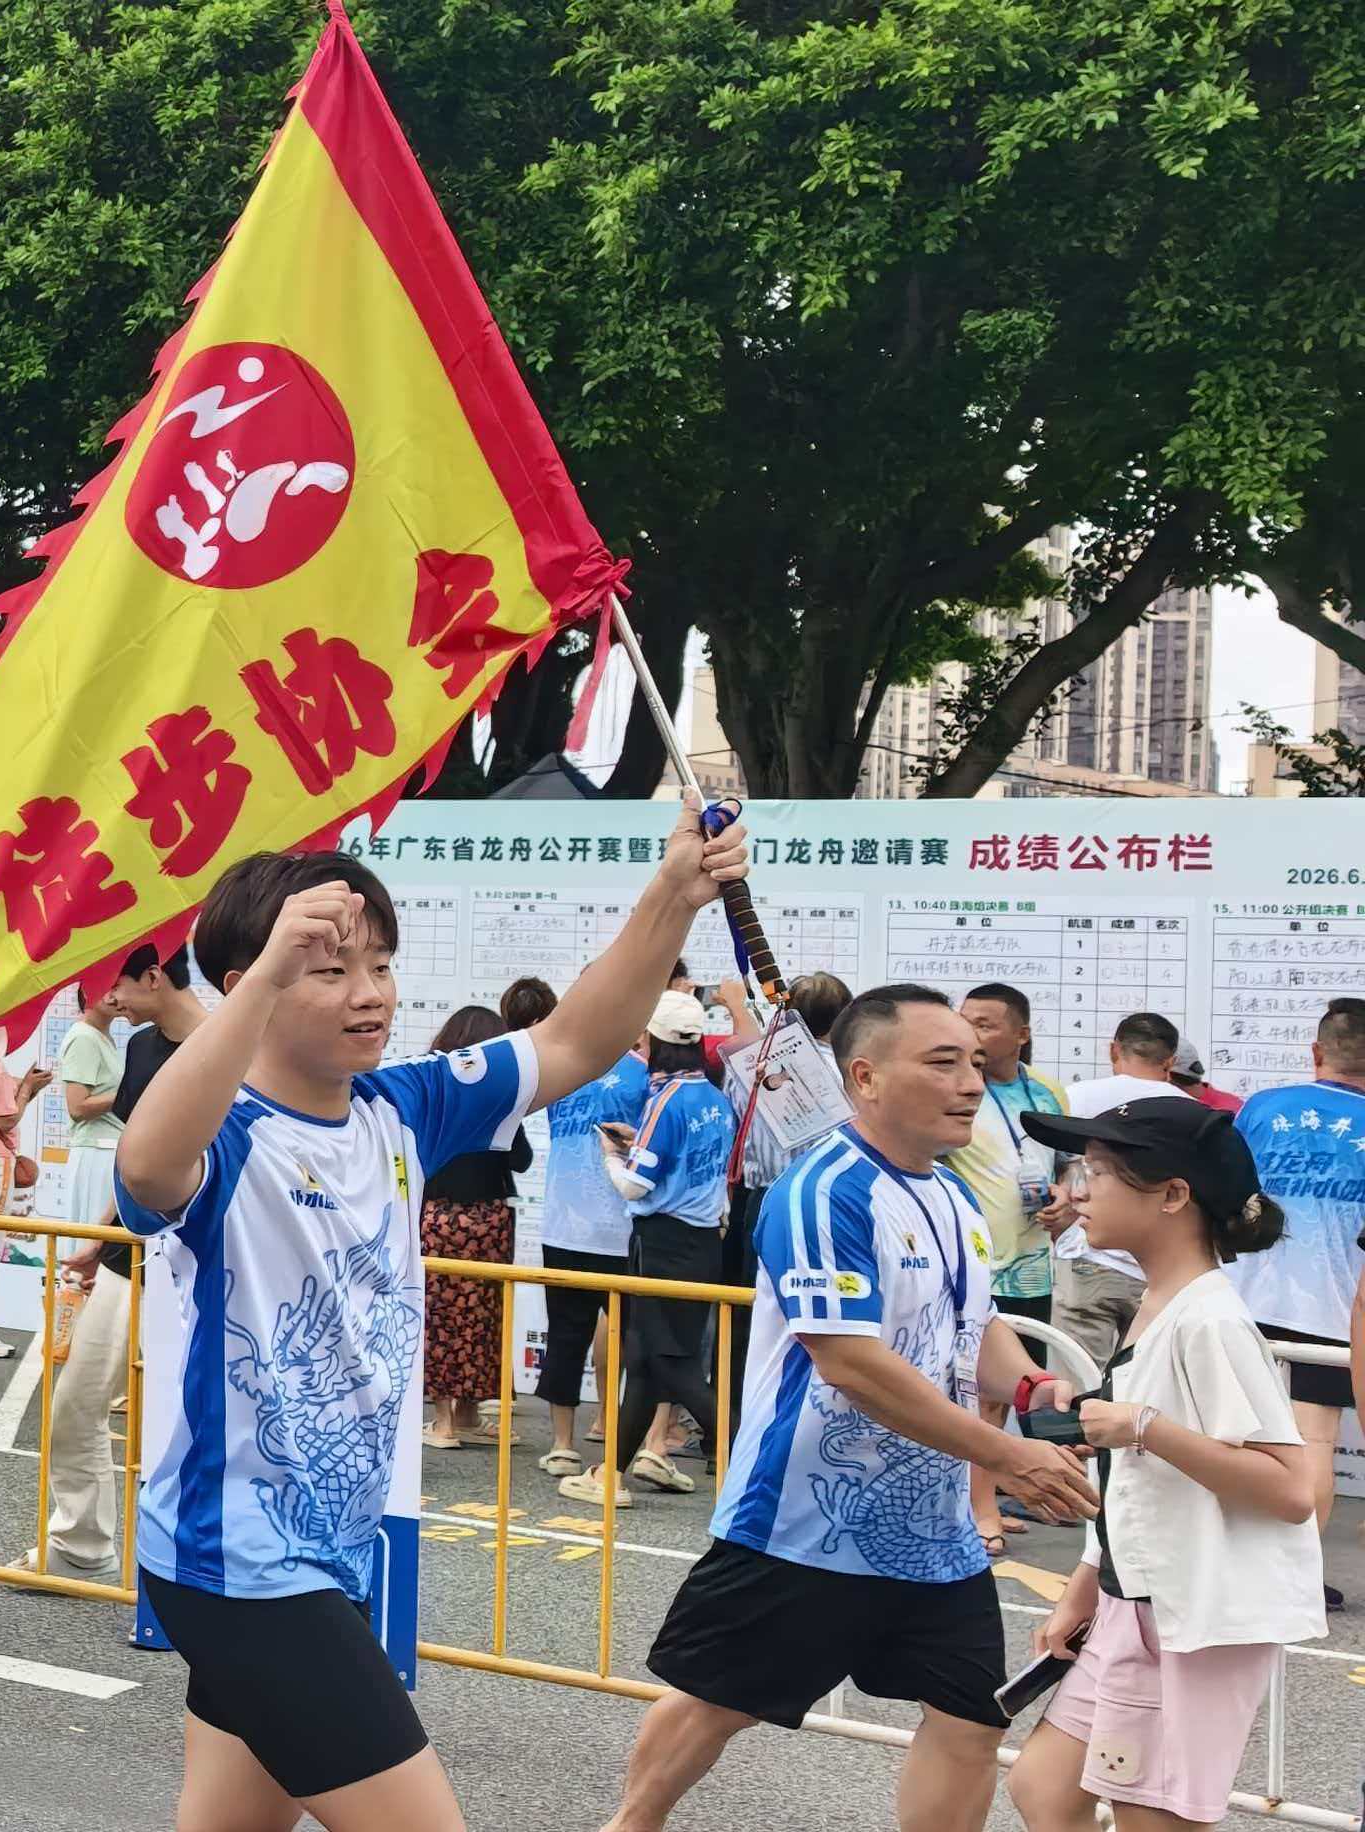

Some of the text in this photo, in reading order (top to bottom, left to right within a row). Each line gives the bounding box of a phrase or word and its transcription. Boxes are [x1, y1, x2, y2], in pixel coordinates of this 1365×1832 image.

[968, 832, 1213, 873] 成绩公布栏
[914, 900, 947, 911] 10:40
[1242, 904, 1279, 914] 11:00
[1282, 904, 1348, 916] 公开组决赛
[1110, 919, 1136, 930] 成绩
[1155, 919, 1180, 931] 名次
[1076, 939, 1083, 950] 1
[1075, 966, 1083, 976] 2
[1074, 992, 1083, 1002] 3
[1073, 1019, 1082, 1030] 4
[1073, 1046, 1081, 1057] 5
